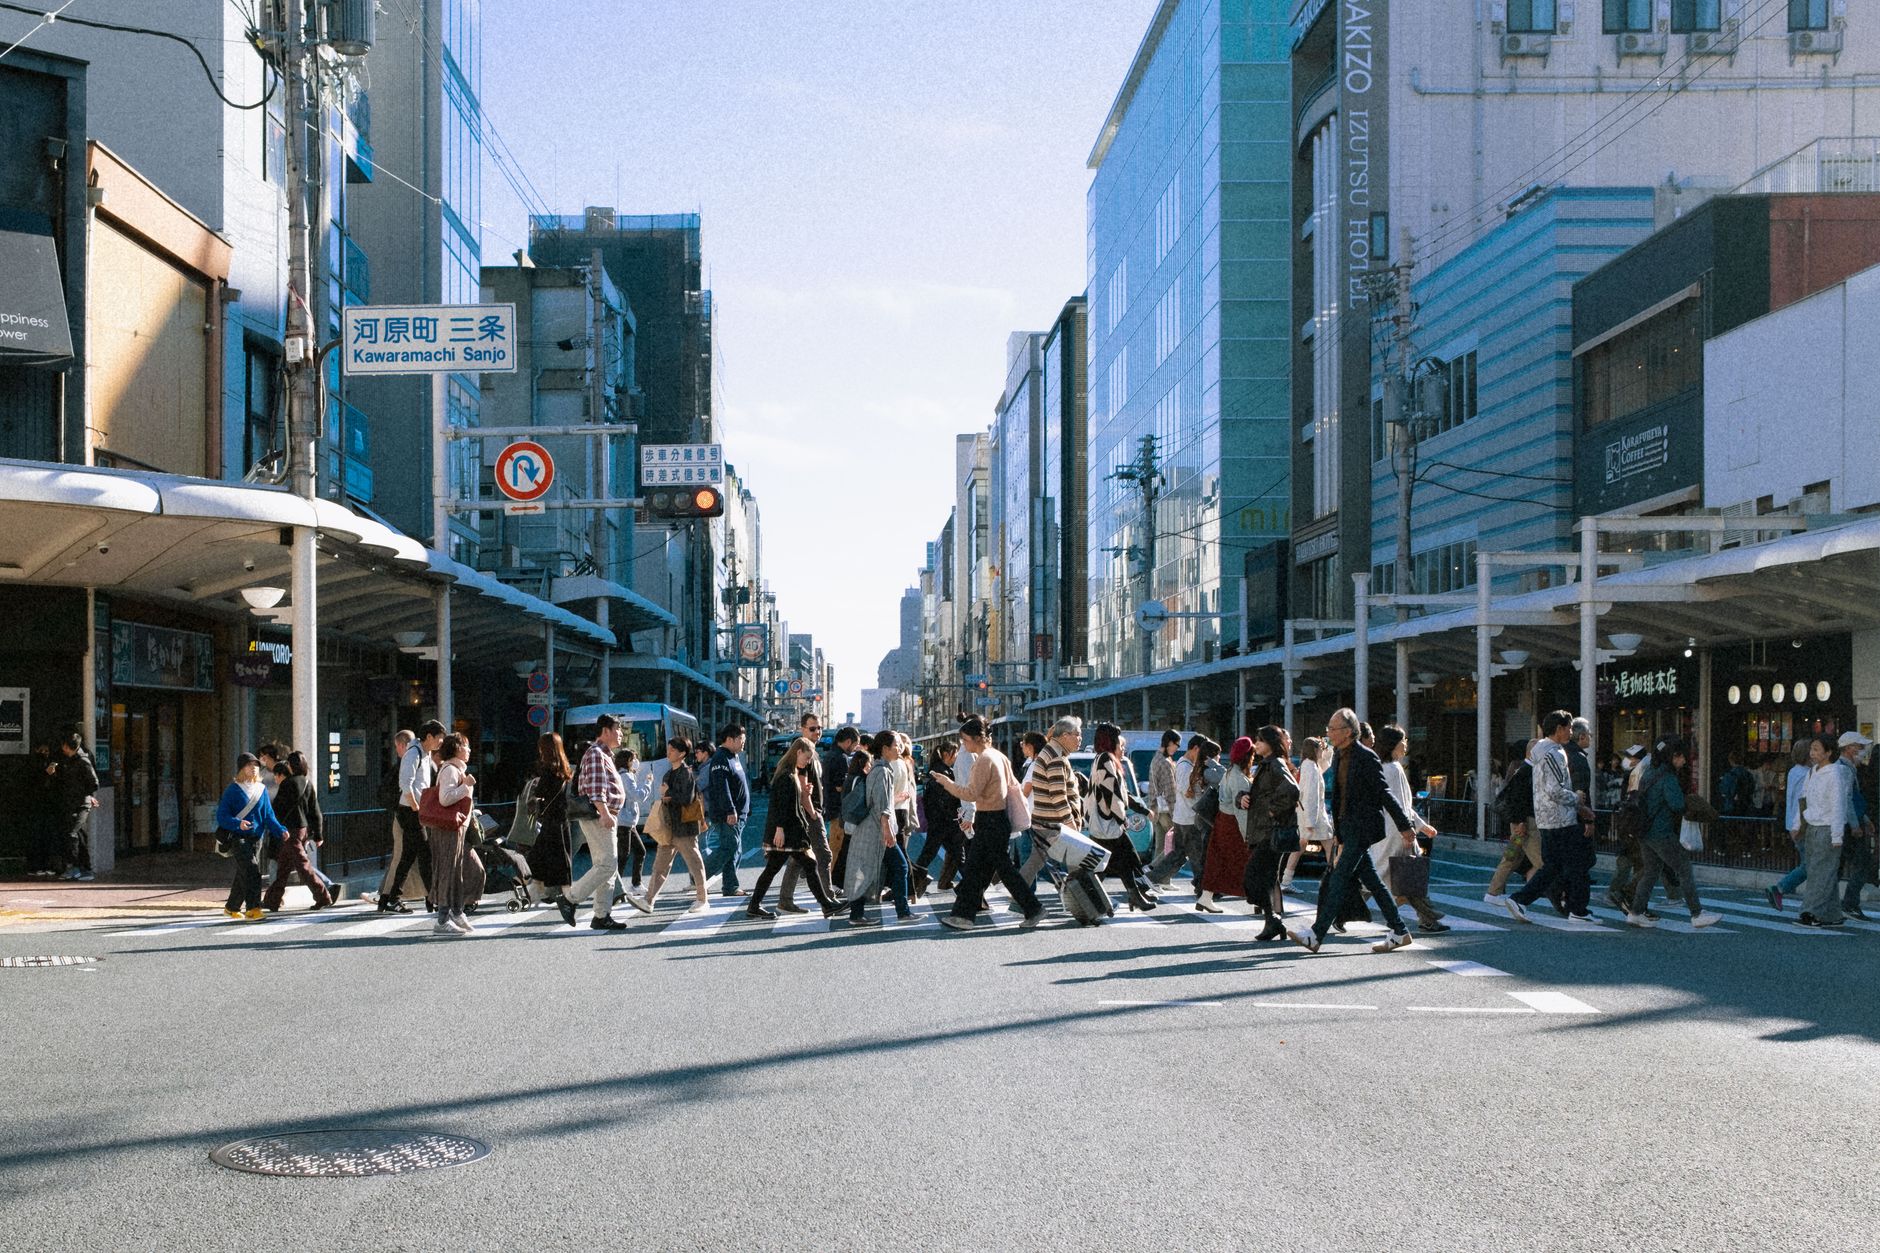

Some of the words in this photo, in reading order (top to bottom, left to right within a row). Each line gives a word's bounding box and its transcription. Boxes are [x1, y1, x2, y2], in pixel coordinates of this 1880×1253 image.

[1344, 0, 1373, 94] AKIZO
[1349, 109, 1369, 207] IZUTSU
[353, 317, 439, 345] 河原町
[448, 316, 506, 342] 三条
[353, 348, 455, 363] Kawaramachi
[463, 346, 506, 364] Sanjo
[644, 447, 718, 462] 歩車分離信号
[645, 468, 719, 482] 時差式信号機
[744, 640, 759, 651] 40
